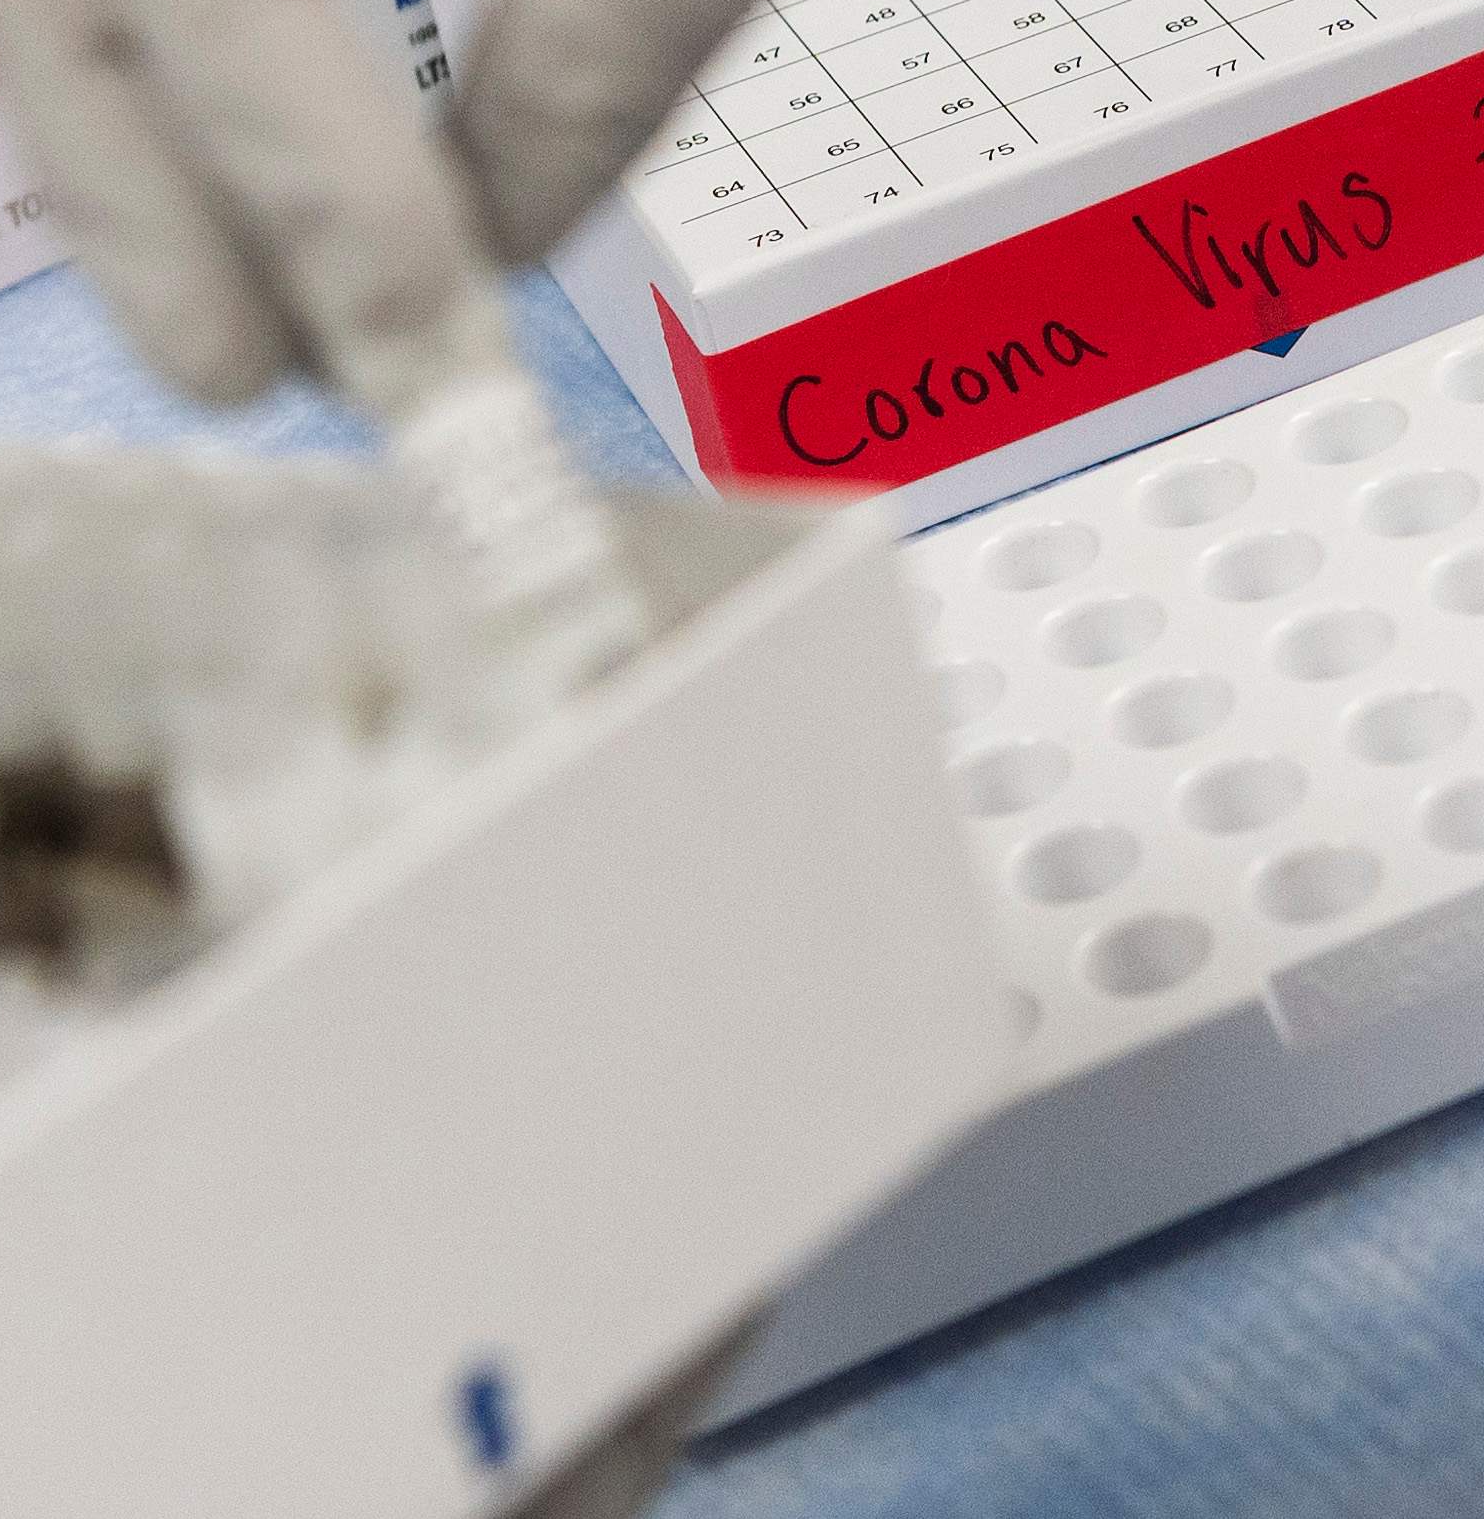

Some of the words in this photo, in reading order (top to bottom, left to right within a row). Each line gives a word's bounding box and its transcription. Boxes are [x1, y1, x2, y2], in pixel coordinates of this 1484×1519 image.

[675, 131, 710, 152] 55
[788, 91, 823, 112] 56
[900, 50, 931, 71] 57
[1012, 11, 1047, 31] 58
[711, 179, 746, 200] 64
[826, 137, 862, 158] 65
[940, 96, 976, 116] 66
[1052, 54, 1083, 75] 67
[1164, 14, 1200, 34] 68
[752, 45, 783, 64] 47
[864, 6, 897, 25] 48
[747, 228, 785, 249] 73
[863, 185, 900, 206] 74
[978, 142, 1016, 163] 75
[1092, 100, 1130, 120] 76
[1205, 58, 1238, 79] 77
[1318, 18, 1356, 37] 78
[778, 318, 1109, 468] Corona
[1132, 172, 1393, 310] Virus
